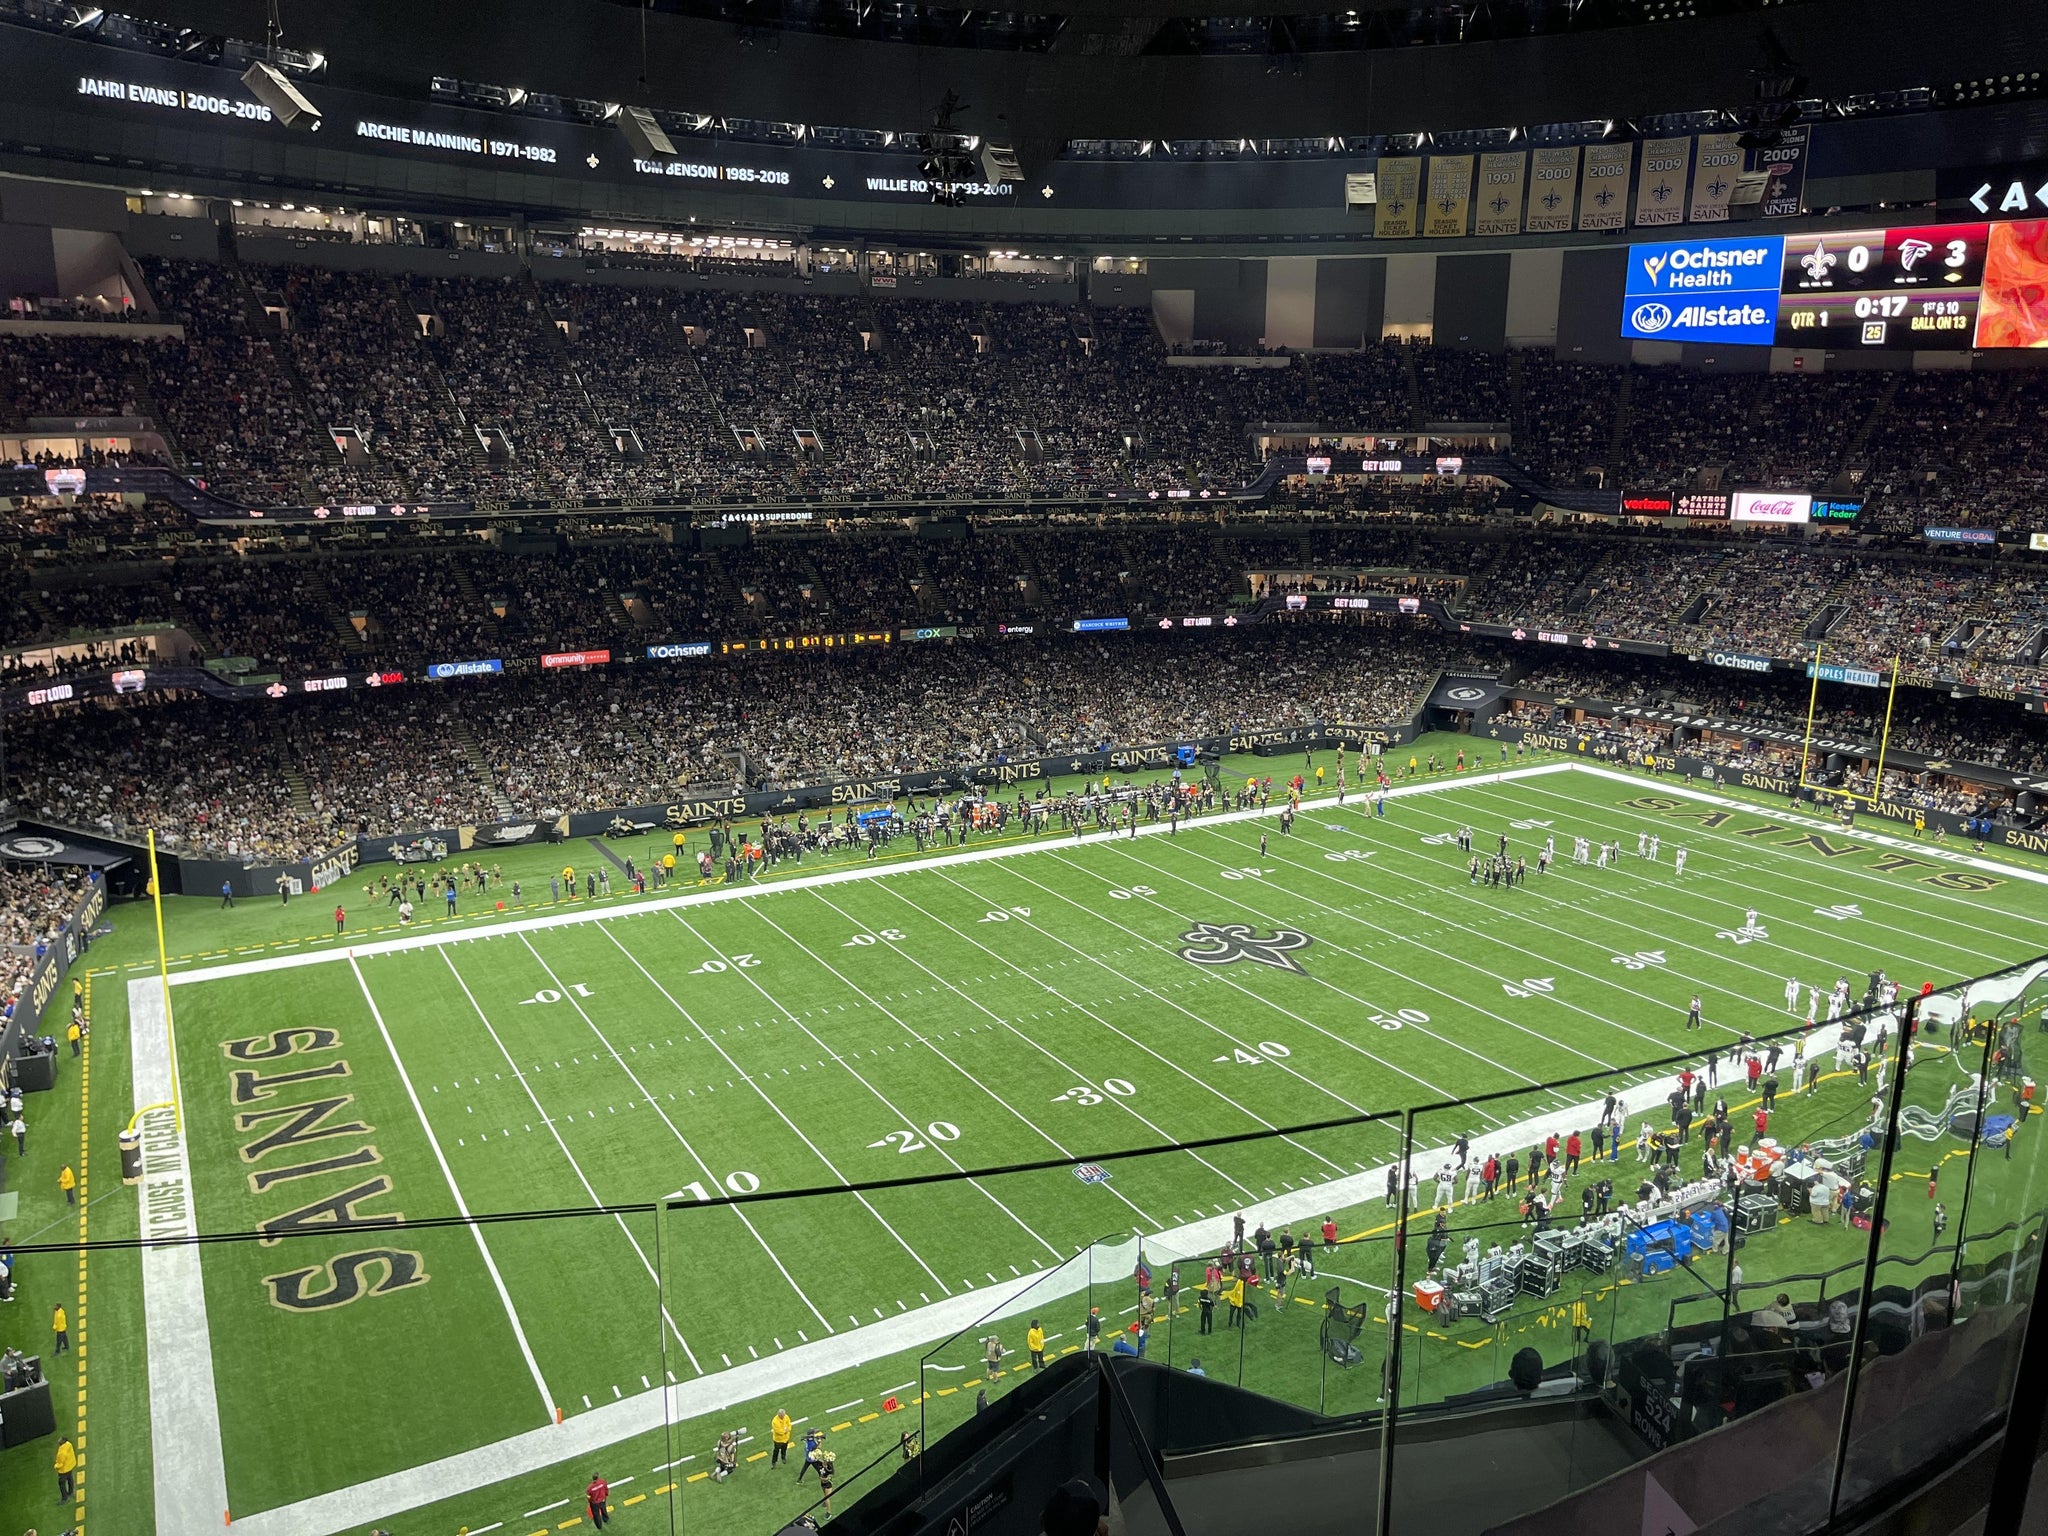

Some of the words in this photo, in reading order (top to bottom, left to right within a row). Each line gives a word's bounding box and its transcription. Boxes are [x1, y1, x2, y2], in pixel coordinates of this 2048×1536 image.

[78, 77, 125, 99] JAHRI
[129, 84, 178, 107] EVANS
[187, 93, 272, 122] 2006-2016
[357, 121, 410, 143] ARCHIE
[412, 130, 481, 152] MANNING
[490, 141, 557, 163] 1971-1982
[1702, 154, 1738, 167] 2009
[1763, 149, 1799, 161] 2009
[633, 159, 663, 174] TOM
[726, 167, 790, 185] 1985-2018
[1589, 165, 1624, 178] 2006
[1647, 159, 1682, 172] 2009
[1487, 172, 1516, 185] 1991
[1537, 168, 1571, 180] 2000
[867, 177, 908, 191] WILLIE
[1639, 212, 1679, 224] SAINTS
[1694, 208, 1729, 220] SAINT
[1478, 223, 1517, 234] SAINTS
[1529, 219, 1568, 230] SAINTS
[1582, 217, 1622, 229] SAINTS
[1669, 247, 1768, 270] Ochsner
[1848, 246, 1869, 272] 0
[1945, 240, 1967, 268] 3
[1669, 269, 1732, 288] Health
[1855, 296, 1908, 318] 0:17
[1922, 302, 1936, 314] 1ST
[1945, 301, 1959, 313] 10
[1791, 312, 1815, 330] QTR
[1820, 311, 1829, 327] 1
[1911, 317, 1935, 330] BALL
[1937, 316, 1951, 329] ON
[1952, 315, 1967, 329] 13
[1866, 326, 1881, 339] 25
[1362, 460, 1378, 471] GET
[1380, 460, 1402, 472] LOUD
[691, 497, 722, 505] SAINTS
[756, 495, 787, 503] SAINTS
[822, 494, 851, 502] SAINTS
[884, 493, 913, 501] SAINTS
[945, 492, 973, 500] SAINTS
[1062, 491, 1090, 499] SAINTS
[475, 502, 510, 511] SAINTS
[550, 500, 584, 509] SAINTS
[621, 498, 654, 506] SAINTS
[1623, 496, 1670, 510] verizon
[343, 506, 357, 516] GET
[358, 506, 376, 515] LOUD
[722, 513, 765, 522] CAESARS
[766, 512, 813, 520] SUPERDOME
[813, 511, 839, 519] SAINTS
[872, 510, 898, 518] SAINTS
[930, 509, 956, 517] SAINTS
[1046, 507, 1071, 515] SAINTS
[1677, 508, 1725, 516] PARTNERS
[487, 519, 519, 528] SAINTS
[558, 518, 589, 526] SAINTS
[625, 515, 655, 523] SAINTS
[330, 525, 366, 535] SAINTS
[409, 523, 443, 532] SAINTS
[1881, 524, 1913, 534] SAINTS
[157, 531, 196, 542] SAINTS
[1924, 529, 1961, 539] VENTURE
[1962, 532, 1994, 541] GLOBAL
[1334, 598, 1349, 608] GET
[1350, 599, 1369, 608] LOUD
[1183, 618, 1195, 626] GET
[1195, 617, 1212, 626] LOUD
[917, 628, 941, 638] COX
[959, 626, 985, 634] SAINTS
[1007, 625, 1033, 634] entergy
[1538, 632, 1550, 641] GET
[1551, 634, 1568, 644] LOUD
[658, 644, 709, 659] Ochsner
[1672, 646, 1703, 657] SAINTS
[504, 657, 537, 668] SAINTS
[545, 653, 586, 667] Community
[1713, 653, 1770, 672] Ochsner
[1808, 665, 1843, 680] POPLES
[1845, 671, 1878, 685] HEALTH
[305, 680, 323, 692] GET
[323, 677, 347, 690] LOUD
[381, 673, 403, 684] 0:04
[1897, 676, 1934, 689] SAINTS
[28, 689, 47, 706] GET
[47, 684, 73, 701] LOUD
[1978, 687, 2016, 701] SAINTS
[1612, 706, 1724, 728] CAESARS
[1726, 724, 1870, 754] SUPERDOME
[1523, 732, 1567, 750] SAINTS
[1110, 746, 1168, 768] SAINTS
[831, 778, 900, 803] SAINTS
[666, 797, 747, 822] SAINTS
[1867, 801, 1925, 822] SAINTS
[1751, 808, 1828, 827] TAKES
[1509, 820, 1549, 830] 10
[1618, 796, 2008, 891] SAINTS
[1324, 849, 1371, 862] 30
[1220, 867, 1263, 881] 40
[1108, 885, 1158, 900] 50
[984, 905, 1032, 922] 40
[1813, 904, 1863, 921] 10
[851, 928, 907, 947] 30
[701, 953, 763, 974] 20
[1611, 950, 1667, 971] 30
[32, 958, 58, 1017] SAINTS
[535, 982, 596, 1004] 10
[1501, 977, 1557, 1000] 40
[1366, 1008, 1431, 1031] 50
[1232, 1040, 1291, 1066] 40
[1066, 1078, 1137, 1106] 30
[143, 1107, 180, 1151] CLEATS
[884, 1121, 961, 1153] 20
[146, 1153, 182, 1174] MY
[218, 1026, 430, 1312] SAINTS
[682, 1171, 760, 1201] 10
[148, 1179, 187, 1224] CAUSE
[1430, 1293, 1439, 1304] G
[1640, 1375, 1678, 1419] SECTION
[1645, 1396, 1670, 1434] 524
[1634, 1411, 1662, 1449] ROWS
[970, 1492, 993, 1514] CAUTION
